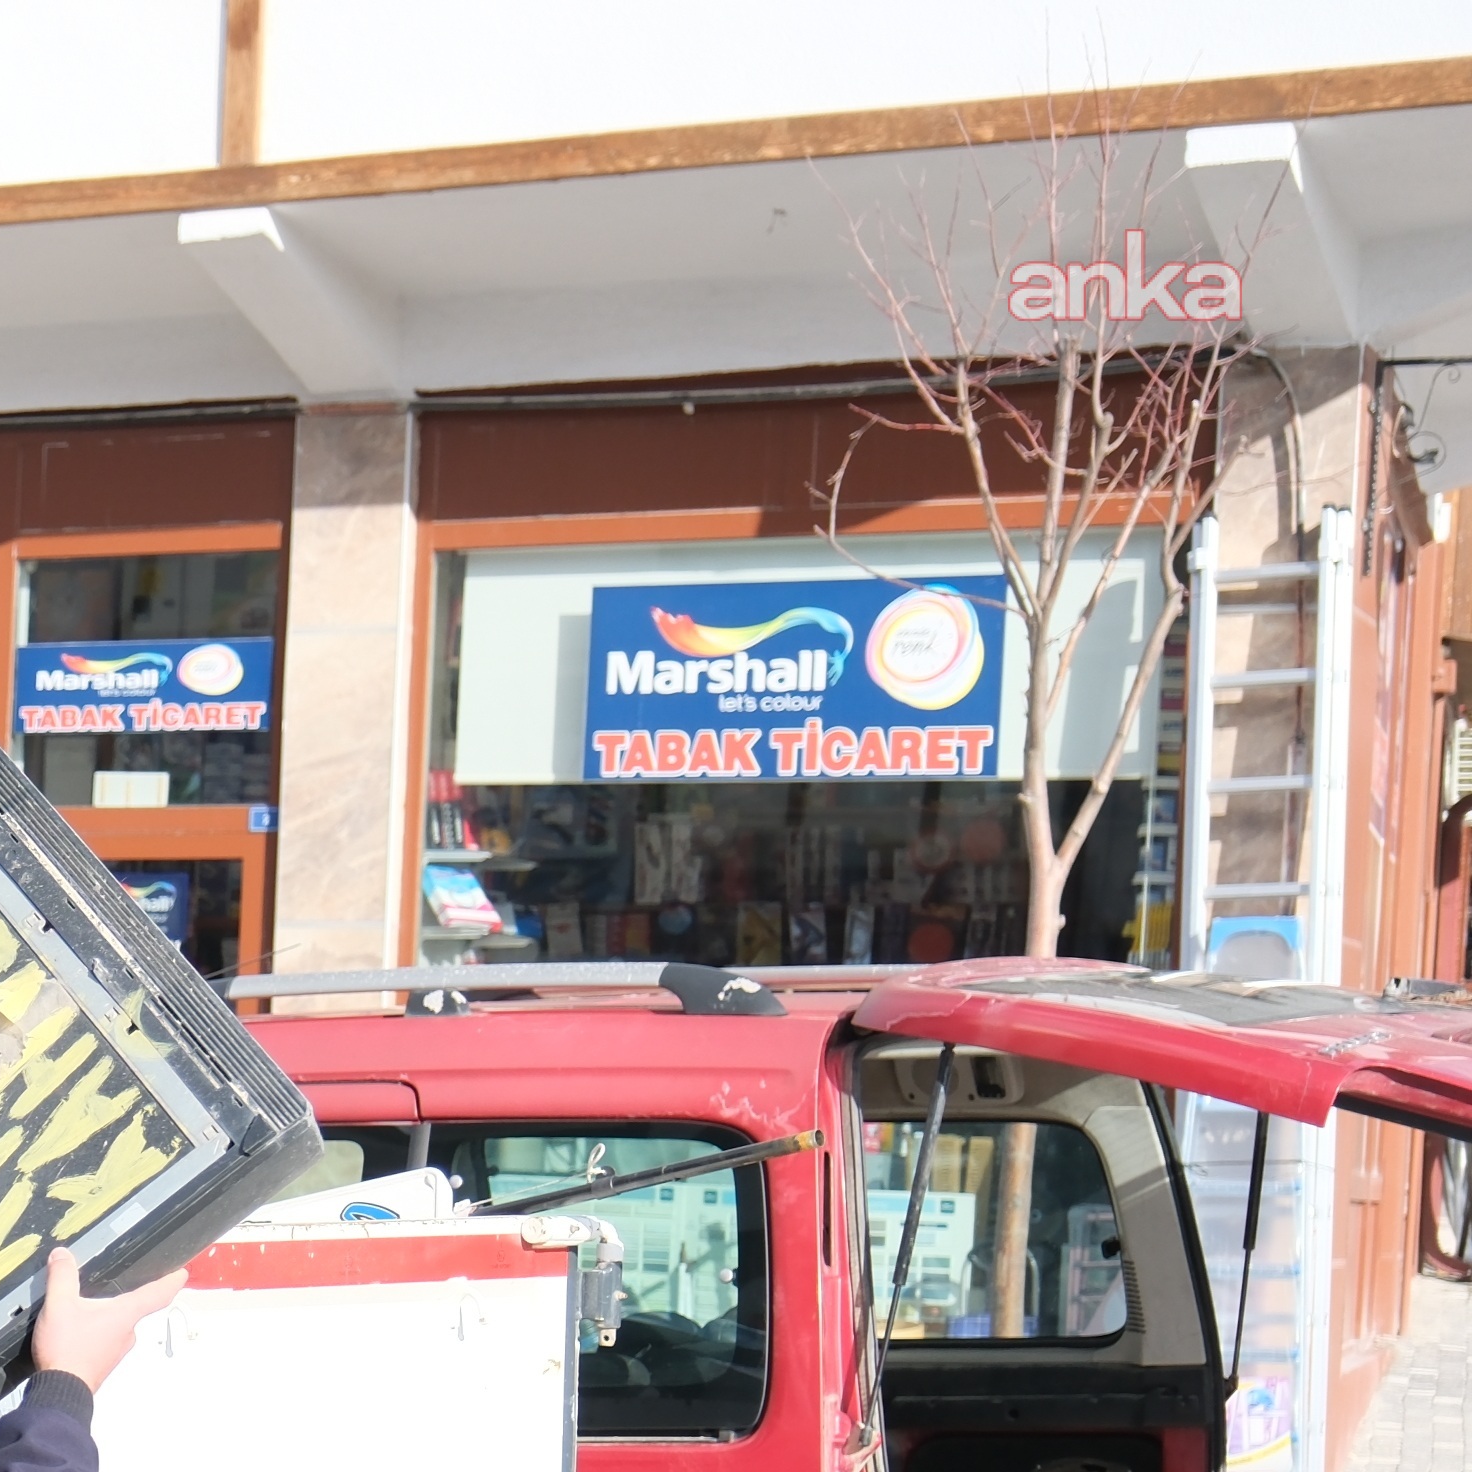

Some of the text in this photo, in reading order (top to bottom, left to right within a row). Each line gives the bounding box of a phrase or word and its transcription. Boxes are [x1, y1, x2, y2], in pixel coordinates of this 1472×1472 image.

[35, 669, 159, 692] Marshall
[606, 649, 828, 695] Marshall
[19, 697, 267, 733] TABAK TİCARET
[760, 694, 824, 712] colour
[593, 717, 994, 778] TABAK TİCARET
